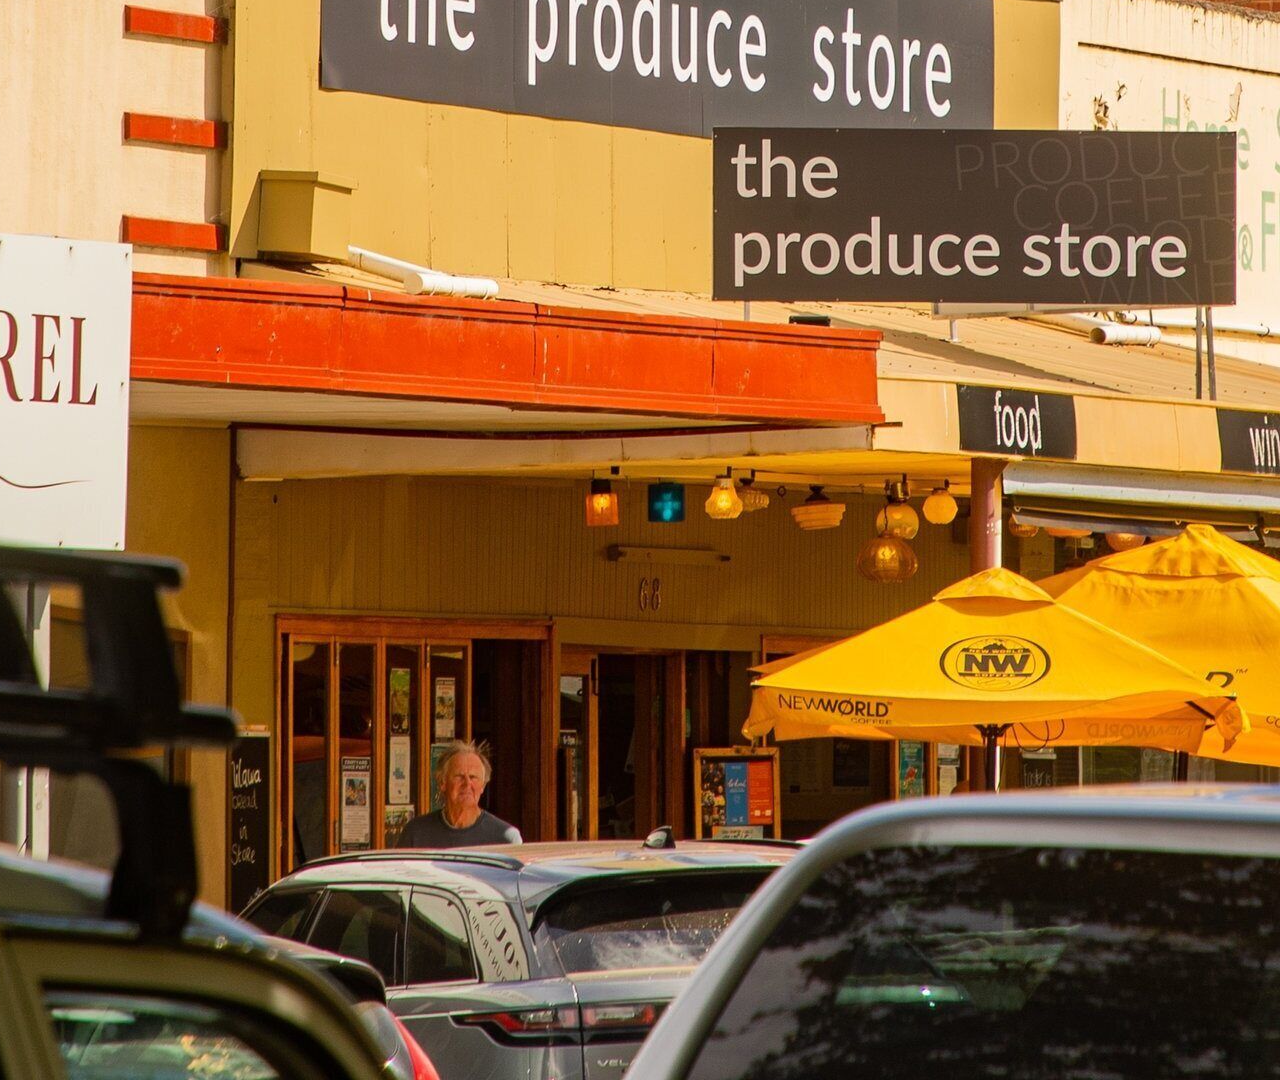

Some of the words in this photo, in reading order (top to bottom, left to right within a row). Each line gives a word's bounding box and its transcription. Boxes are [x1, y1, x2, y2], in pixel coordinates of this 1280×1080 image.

[812, 8, 952, 118] store
[731, 138, 839, 200] the
[735, 217, 1000, 287] produce
[1023, 223, 1188, 278] store
[994, 389, 1042, 457] food
[639, 577, 661, 612] 68
[963, 654, 1030, 673] NW
